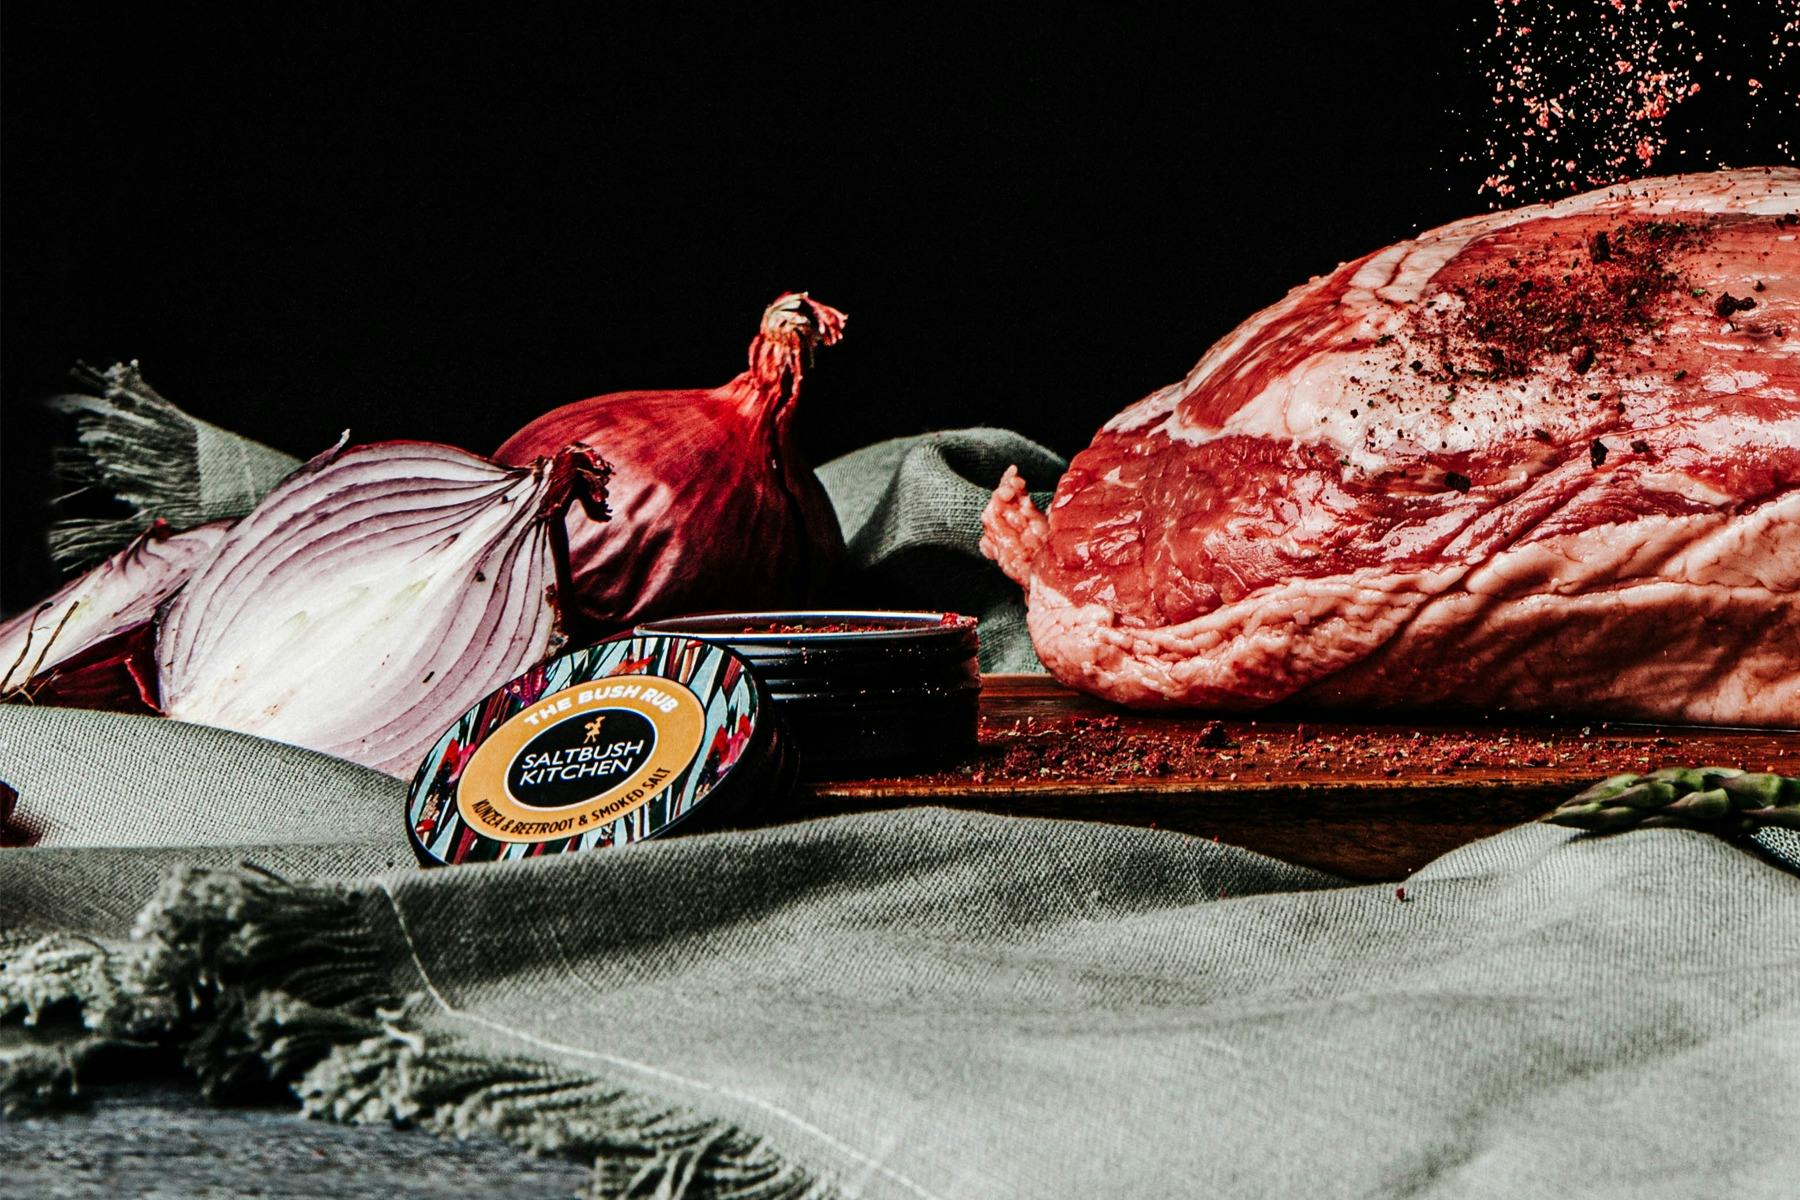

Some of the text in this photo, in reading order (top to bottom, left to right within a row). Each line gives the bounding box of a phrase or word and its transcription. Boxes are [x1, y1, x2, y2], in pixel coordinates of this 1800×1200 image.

[524, 685, 680, 727] THE BUSH RUB
[519, 758, 632, 786] KITCHEN
[522, 740, 644, 769] SALTBUSH
[472, 768, 671, 835] KUNZEA & BEETROOT & SMOKED SALT
